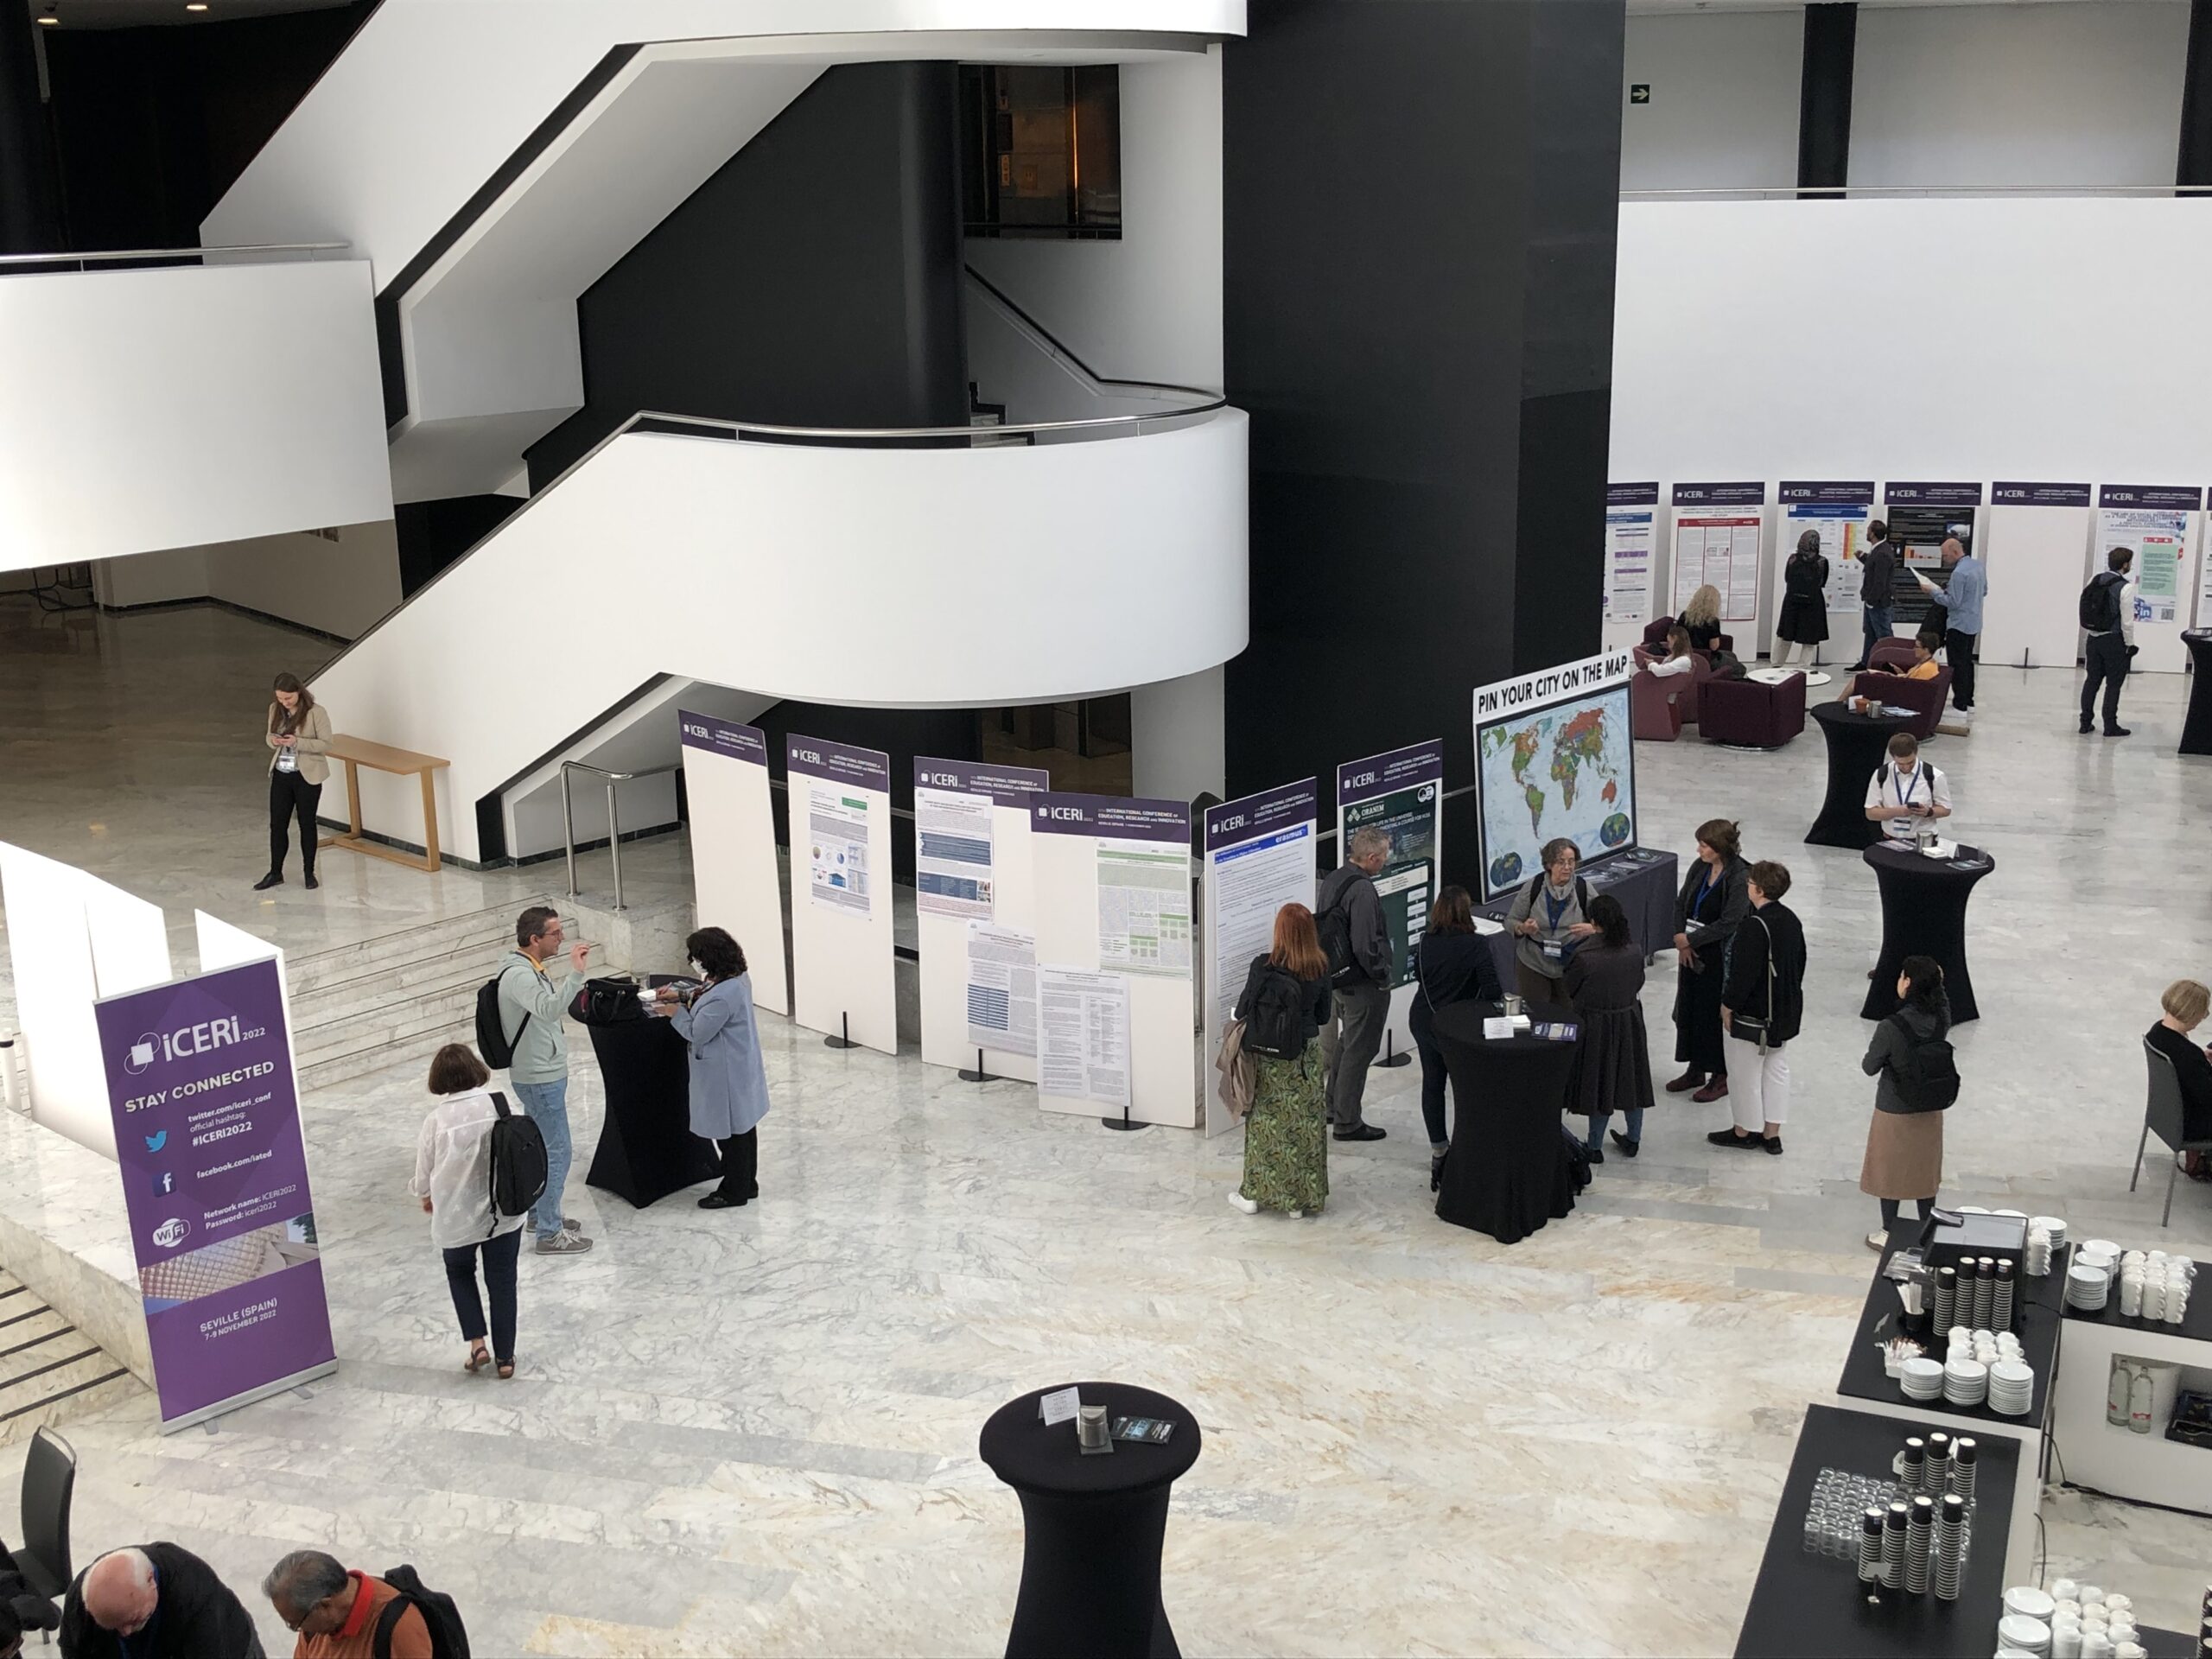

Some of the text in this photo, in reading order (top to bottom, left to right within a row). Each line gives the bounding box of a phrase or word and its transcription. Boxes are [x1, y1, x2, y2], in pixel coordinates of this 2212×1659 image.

[1478, 655, 1627, 714] PIN YOUR CITY ON THE MAP
[1051, 807, 1084, 821] iCERi
[162, 1015, 266, 1062] iCERi 2022
[124, 1061, 275, 1113] STAY CONNECTED
[188, 1091, 271, 1122] twitter.com/iceri_conf
[189, 1112, 247, 1132] official hashtag:
[192, 1121, 252, 1147] #ICERI2022
[196, 1149, 272, 1179] facebook.com/iated
[204, 1203, 237, 1220] Network
[237, 1196, 261, 1209] name:
[206, 1201, 276, 1230] Password: iceri2022
[200, 1298, 277, 1332] SEVILLE (SPAIN)
[204, 1310, 276, 1341] 7-9 NOVEMBER 2022
